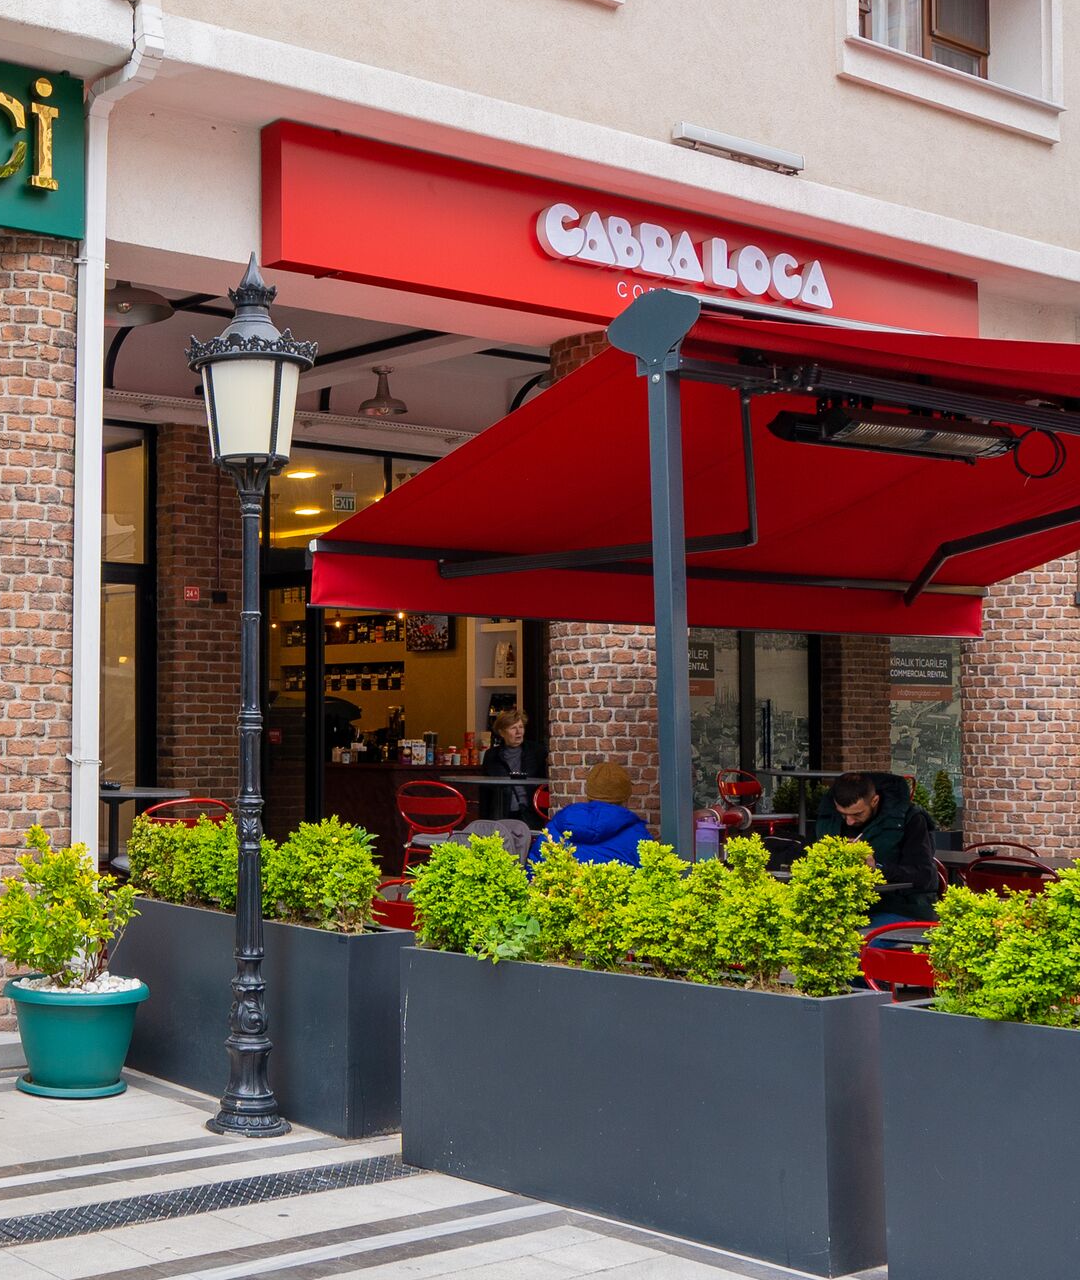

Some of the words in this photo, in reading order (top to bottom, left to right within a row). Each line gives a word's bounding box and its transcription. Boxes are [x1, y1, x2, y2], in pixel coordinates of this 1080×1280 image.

[536, 202, 705, 283] CABRA
[702, 236, 834, 310] LOCA
[334, 497, 354, 510] EXIT
[889, 669, 927, 678] COMMERCIAL
[927, 670, 949, 679] RENTAL
